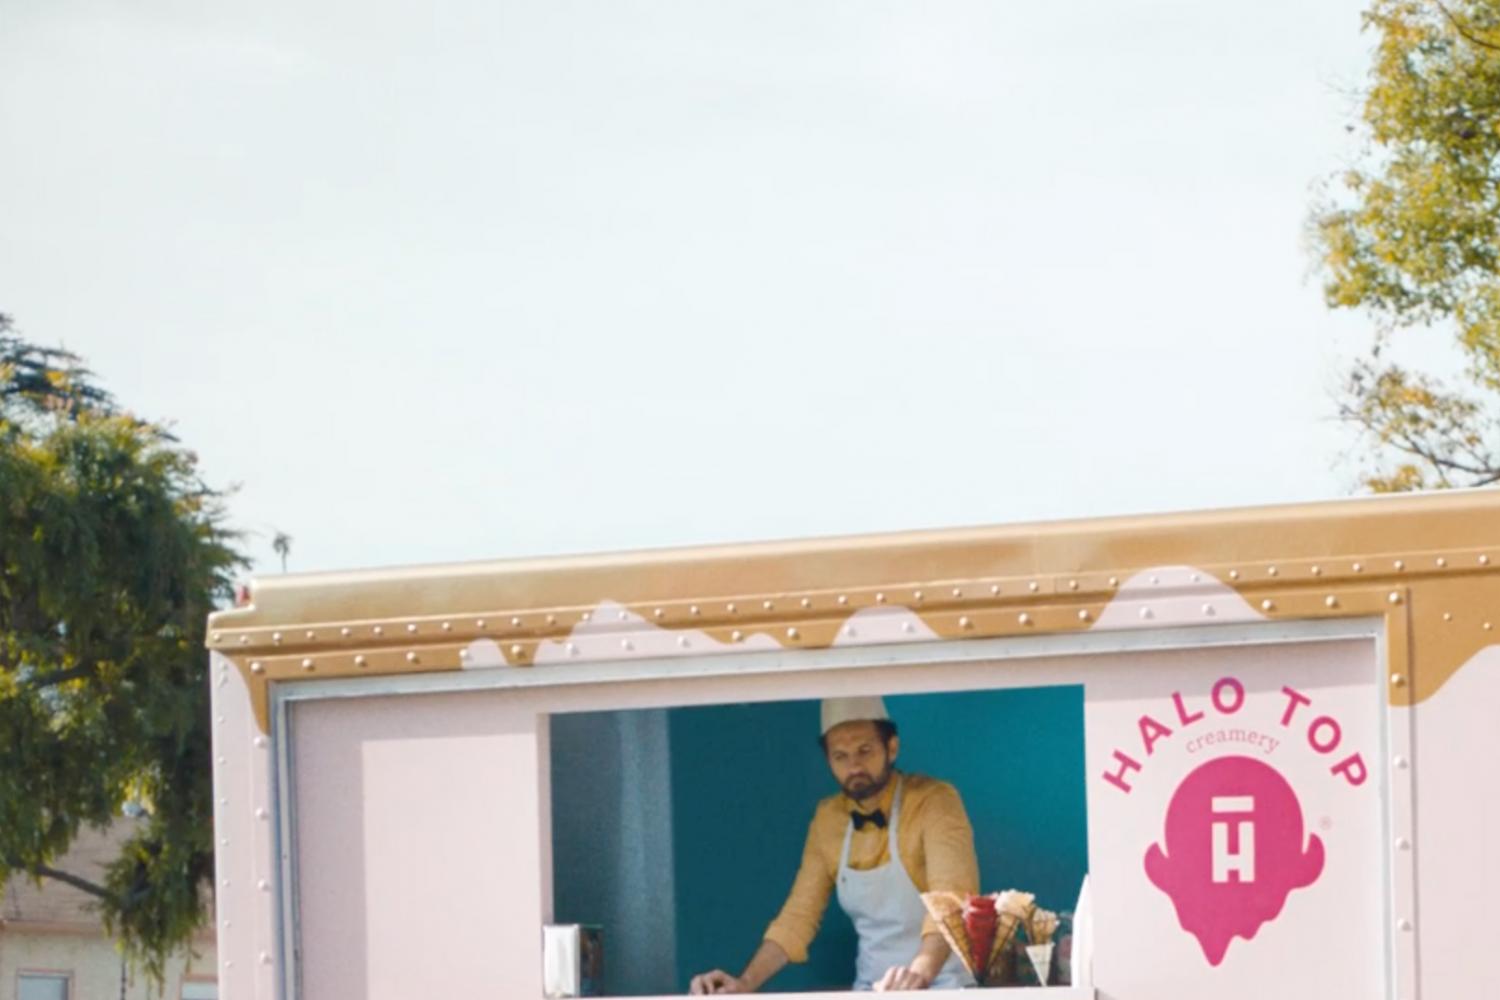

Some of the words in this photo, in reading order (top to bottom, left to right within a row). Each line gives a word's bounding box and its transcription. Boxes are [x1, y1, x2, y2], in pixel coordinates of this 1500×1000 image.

[1102, 677, 1245, 794] HALO
[1280, 686, 1368, 787] TOP
[1185, 728, 1280, 755] creamery
